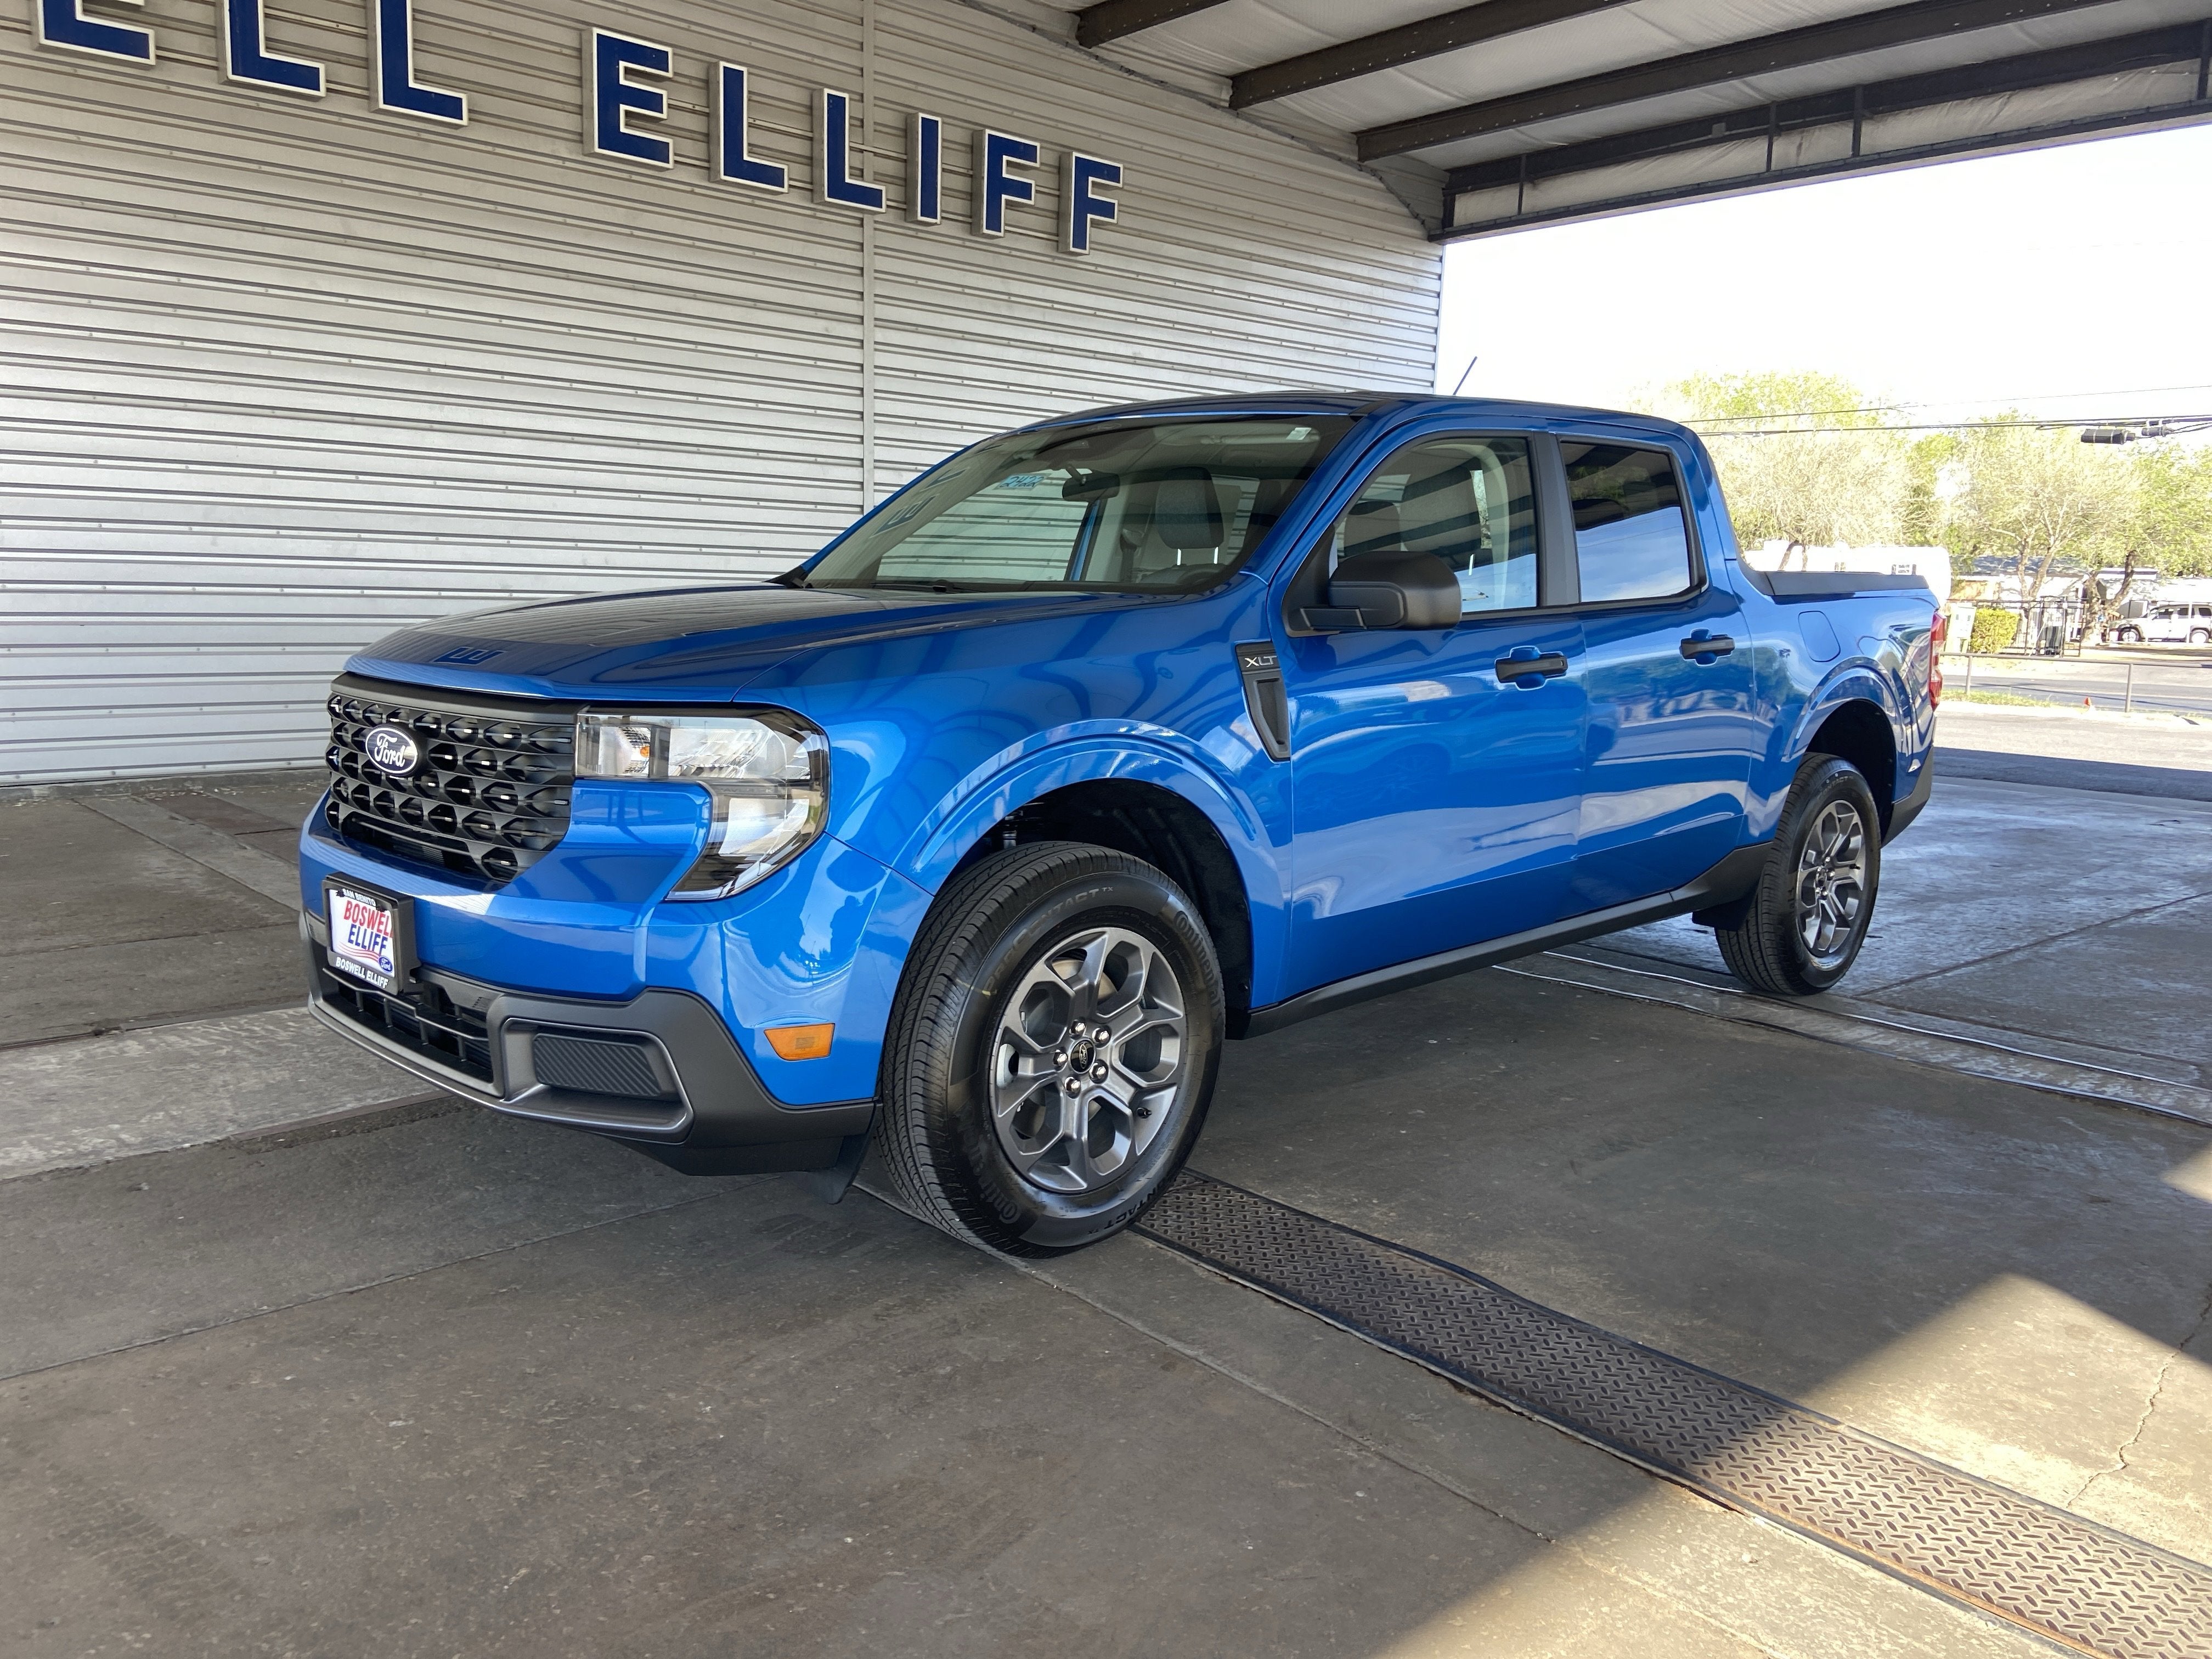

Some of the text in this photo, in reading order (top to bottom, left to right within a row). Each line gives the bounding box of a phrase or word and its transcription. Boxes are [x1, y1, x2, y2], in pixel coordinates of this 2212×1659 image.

[584, 27, 1124, 256] ELLIFF
[1244, 656, 1277, 668] XLT
[374, 733, 405, 767] Ford
[342, 888, 376, 906] SAN BENITO
[348, 923, 388, 956] ELLIFF
[336, 957, 388, 989] BOSWELL ELLIFF
